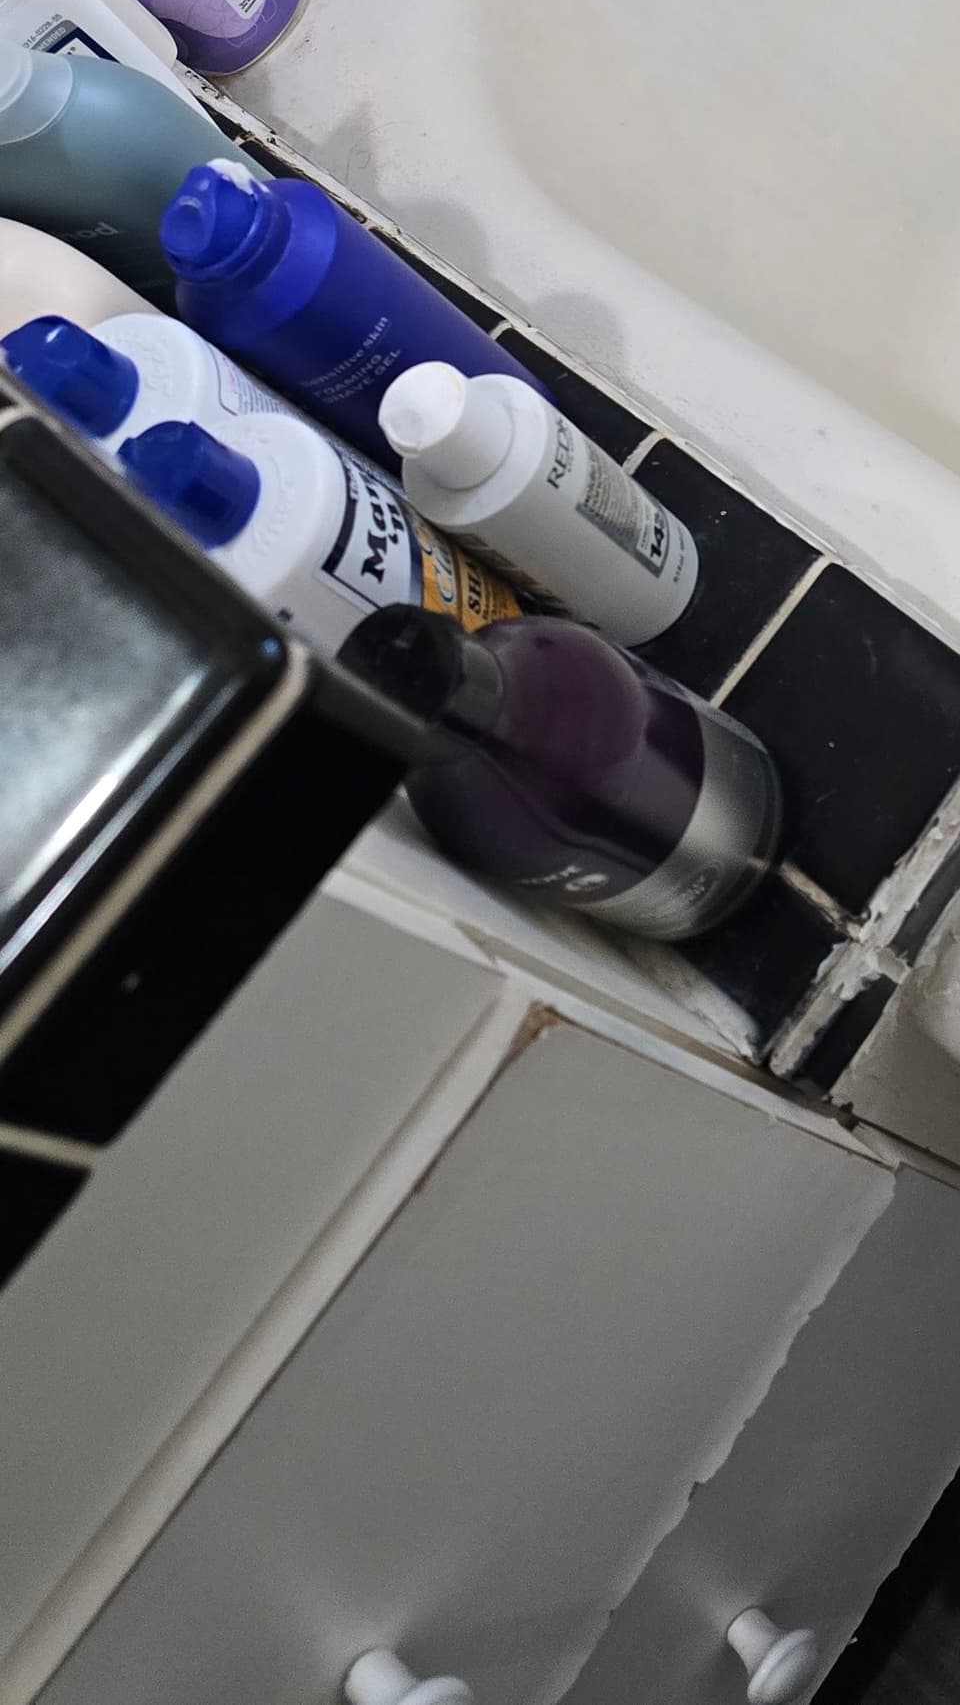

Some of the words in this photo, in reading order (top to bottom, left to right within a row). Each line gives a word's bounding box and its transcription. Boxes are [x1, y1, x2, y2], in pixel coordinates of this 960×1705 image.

[362, 316, 389, 347] Skin
[313, 354, 382, 397] FOAMING
[374, 348, 401, 376] GEL
